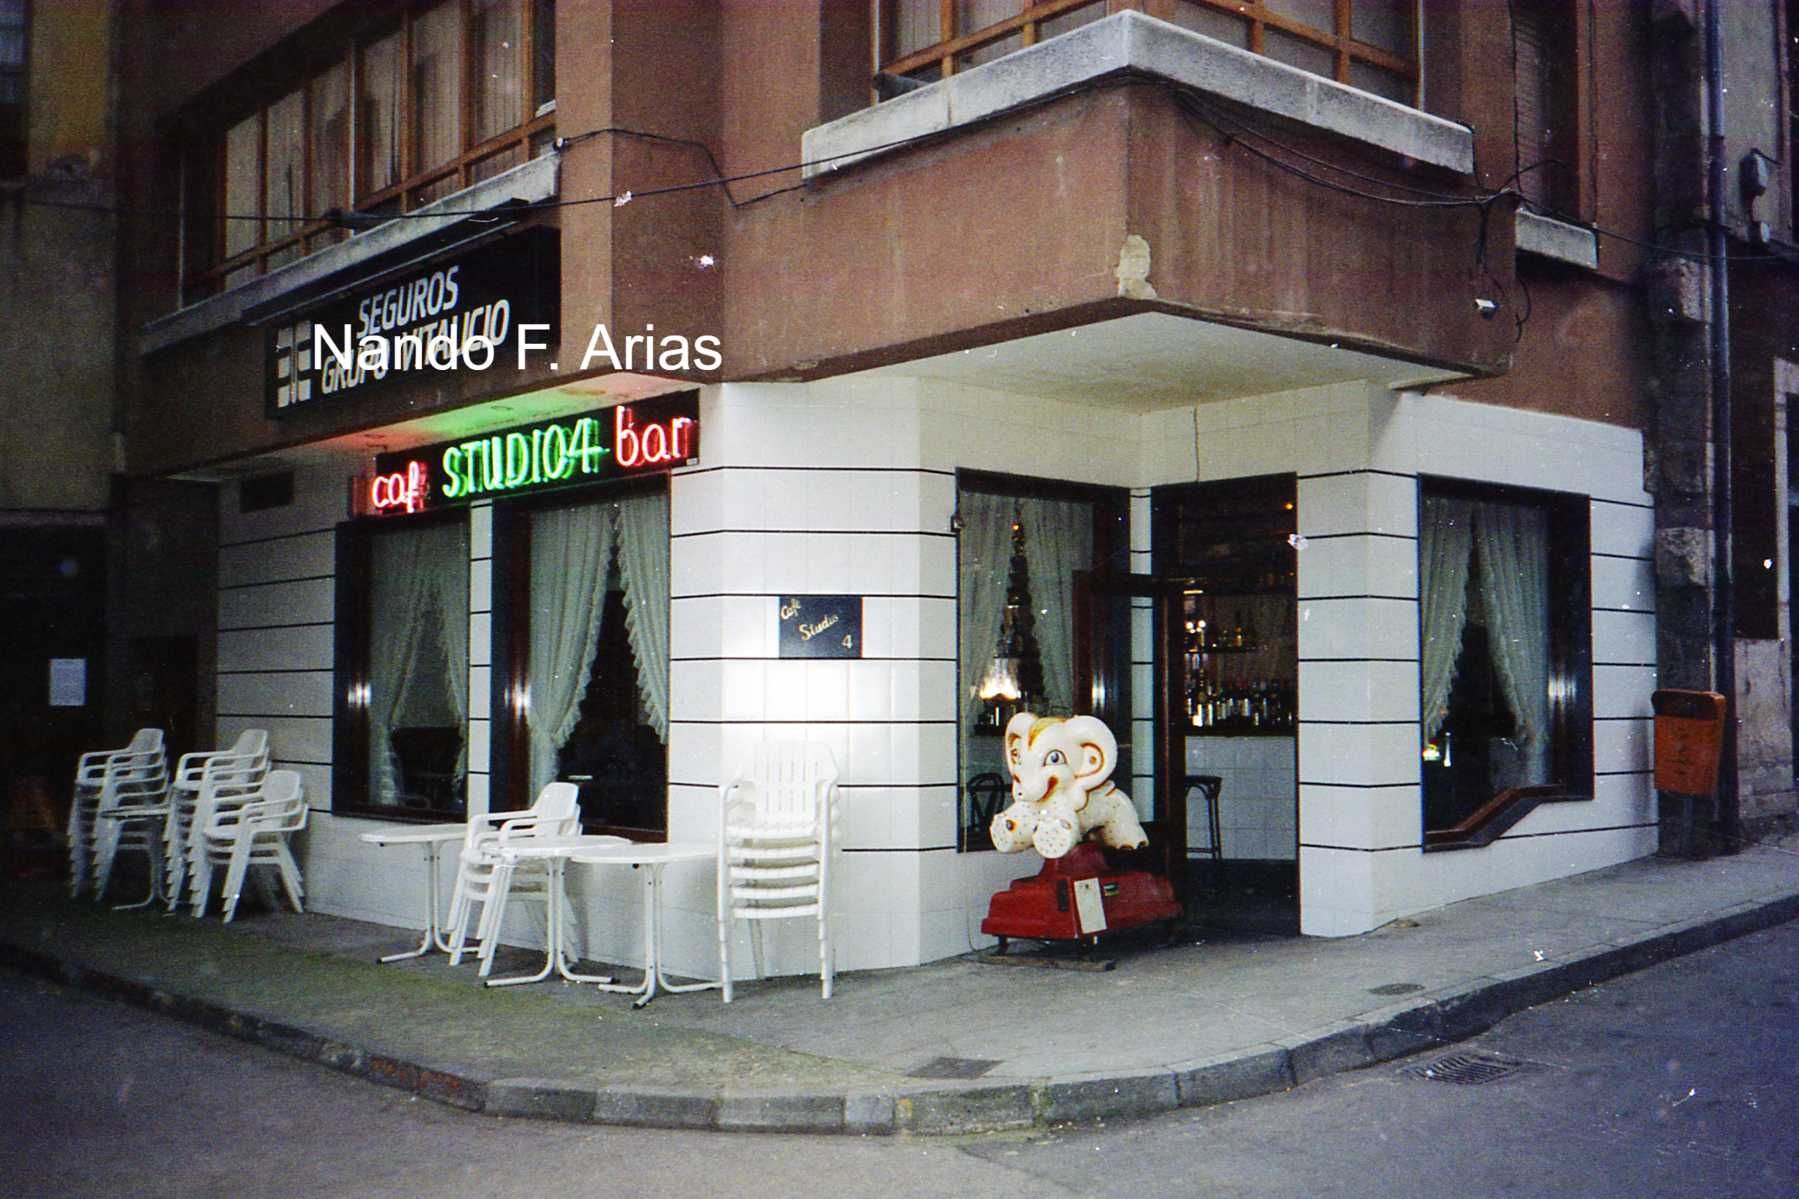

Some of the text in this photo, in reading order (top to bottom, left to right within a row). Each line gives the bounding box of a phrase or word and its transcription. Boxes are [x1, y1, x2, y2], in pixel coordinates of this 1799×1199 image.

[356, 265, 459, 340] SEGUROS
[615, 405, 692, 467] bar
[799, 614, 839, 641] Studio
[841, 633, 853, 649] 4
